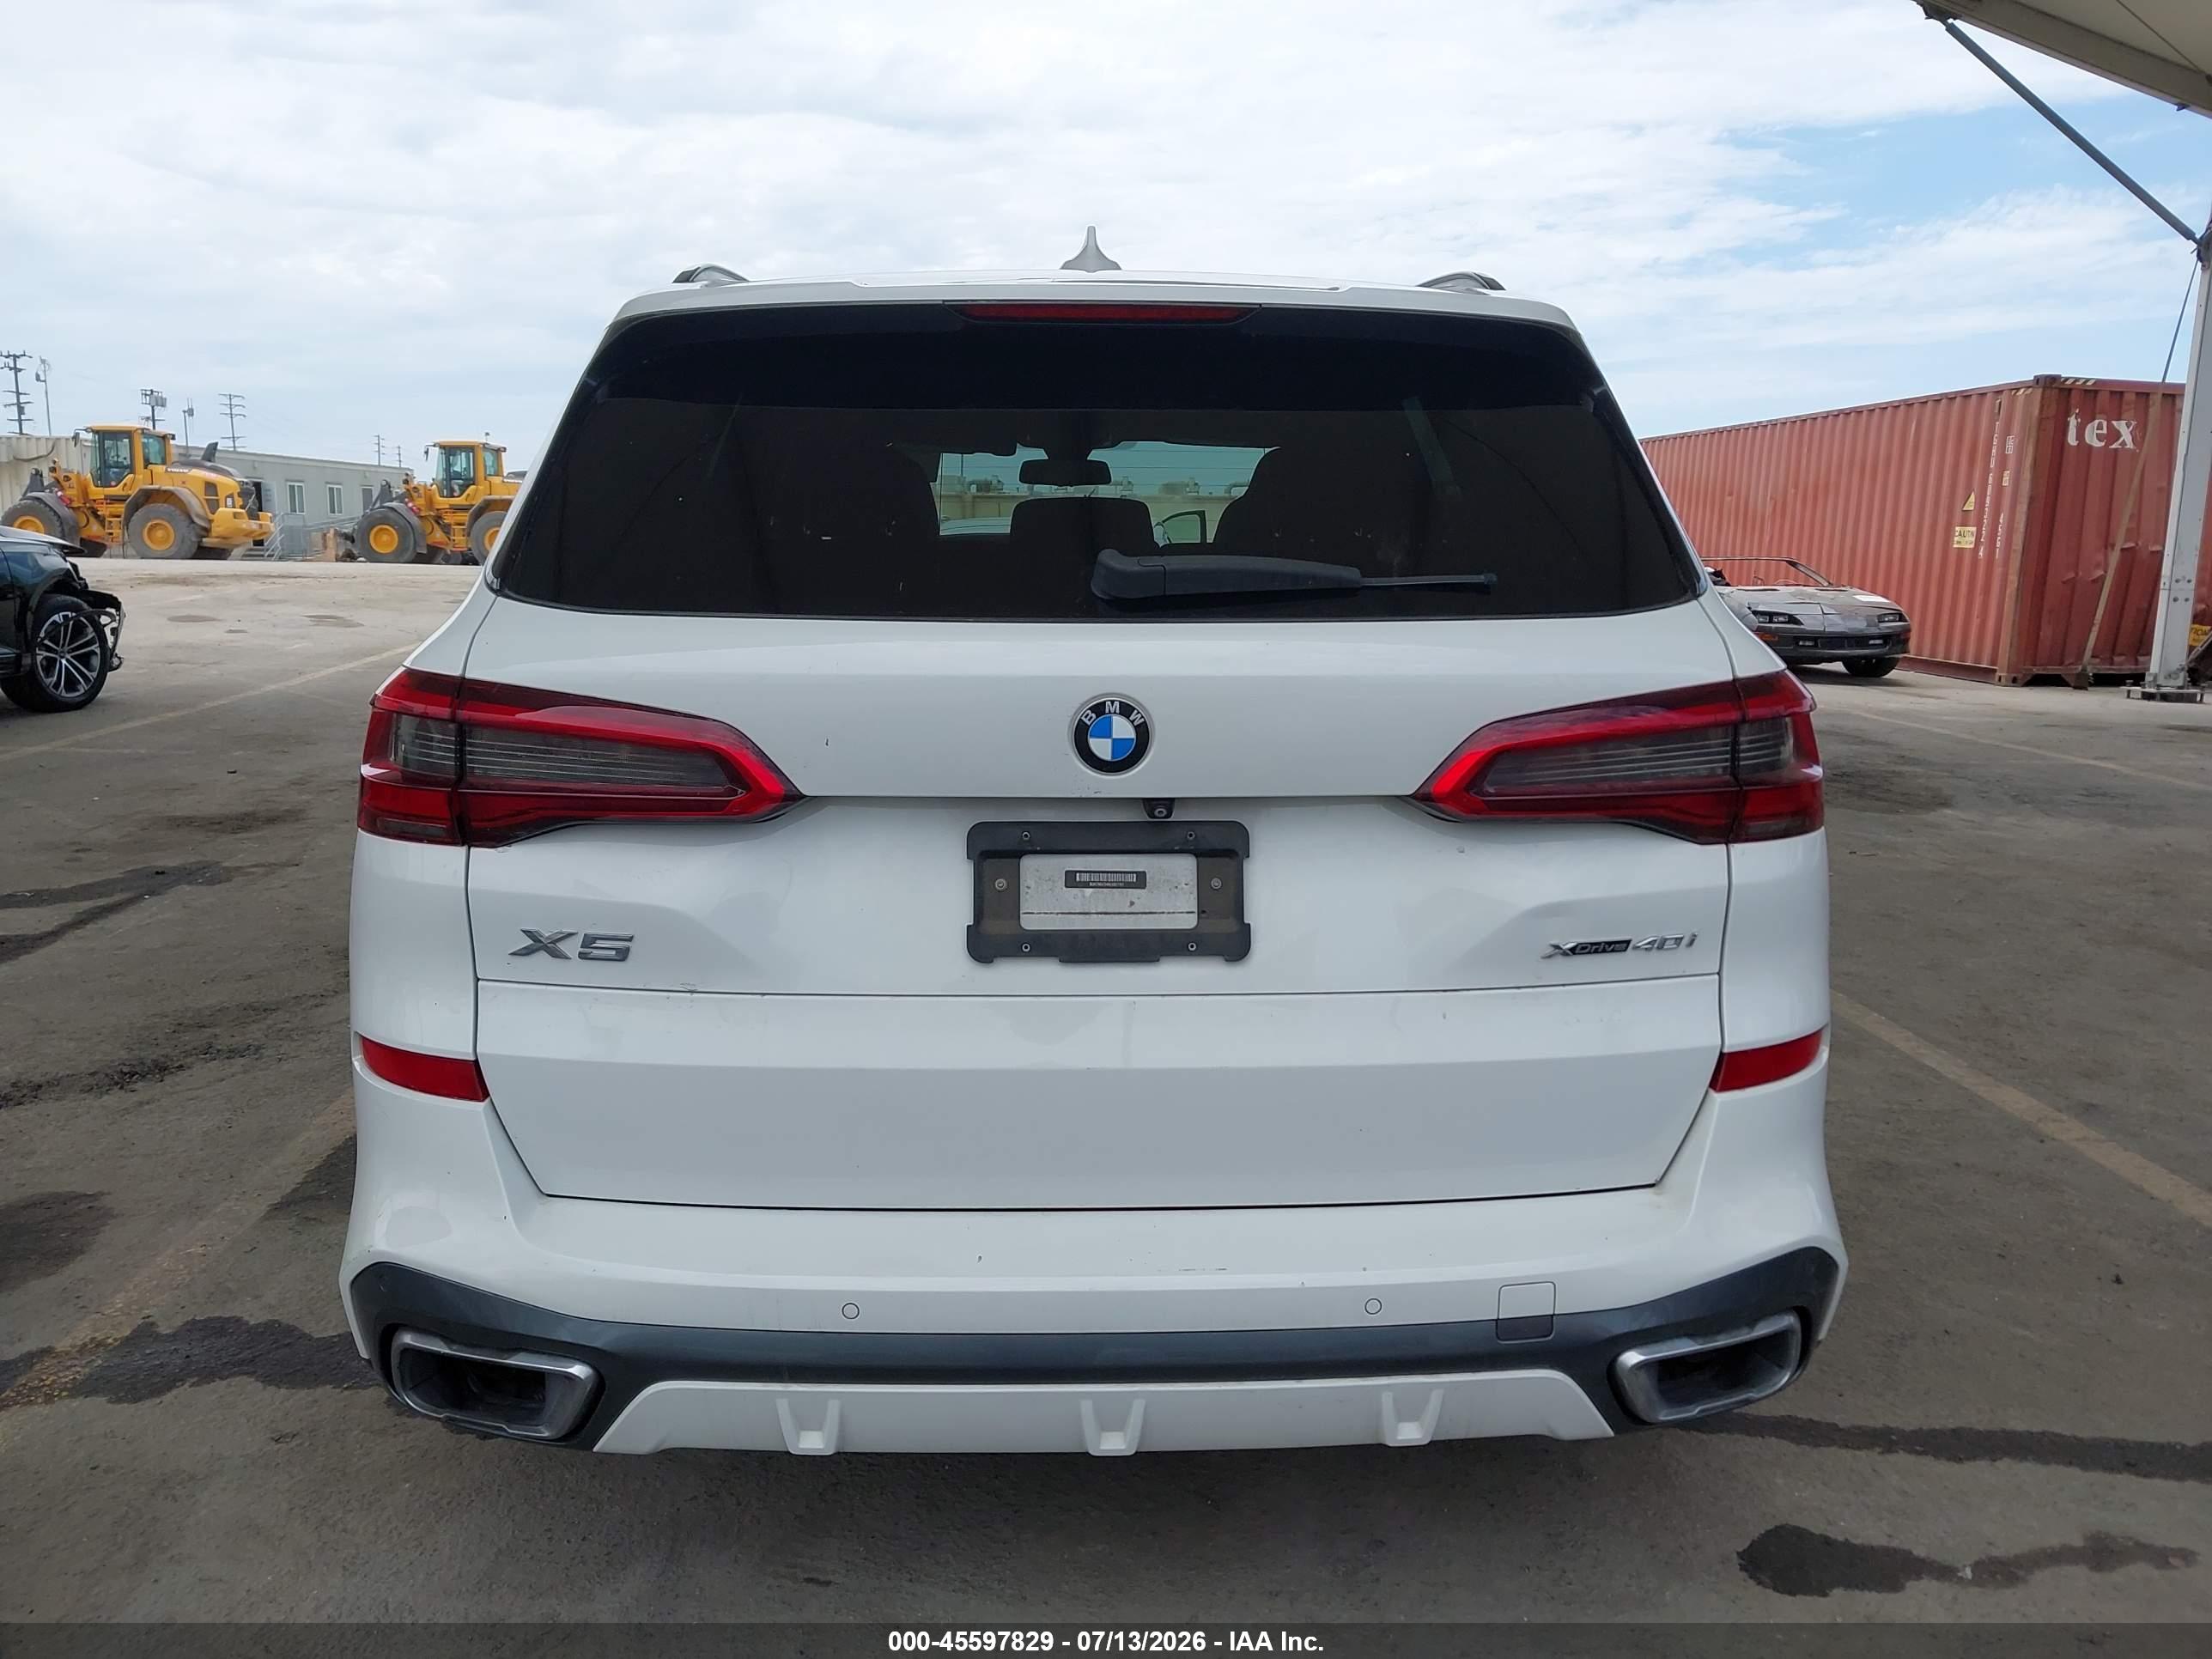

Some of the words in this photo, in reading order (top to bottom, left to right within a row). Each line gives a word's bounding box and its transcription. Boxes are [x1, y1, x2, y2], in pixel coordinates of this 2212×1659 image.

[2067, 409, 2137, 448] tex
[1081, 701, 1145, 726] BMW
[508, 928, 635, 962] X5
